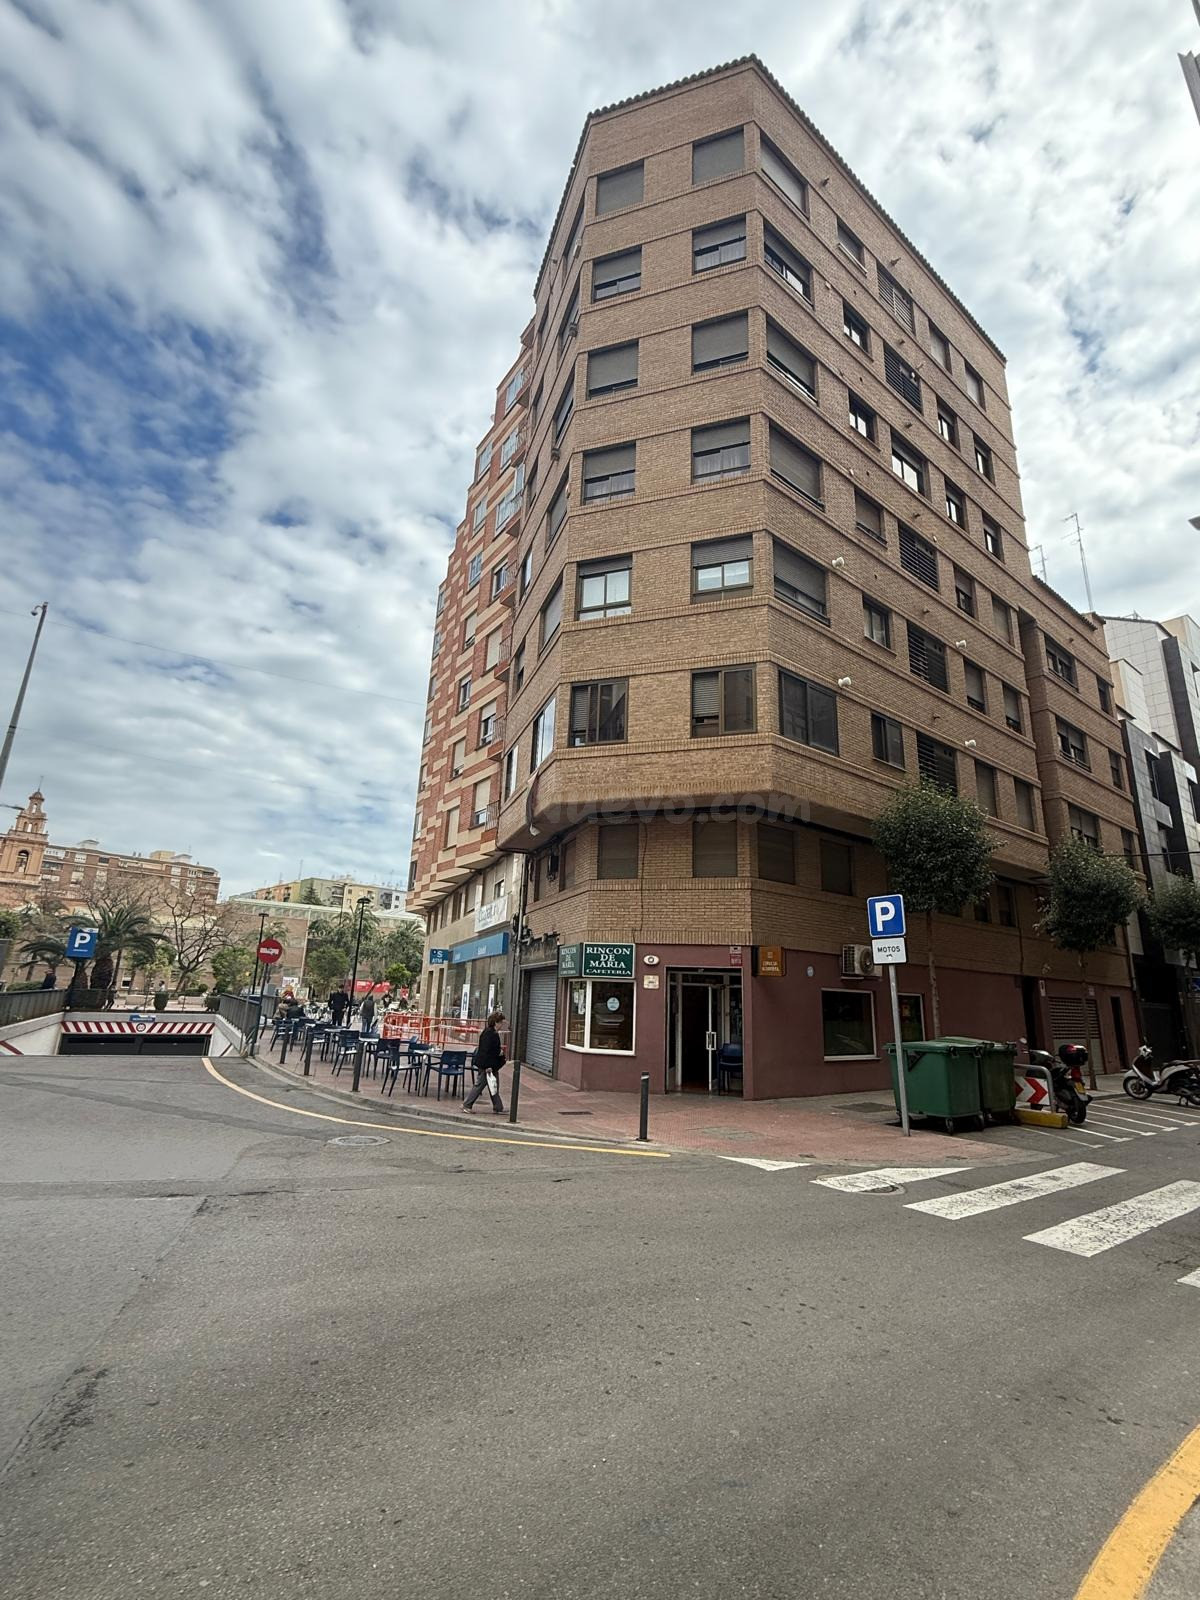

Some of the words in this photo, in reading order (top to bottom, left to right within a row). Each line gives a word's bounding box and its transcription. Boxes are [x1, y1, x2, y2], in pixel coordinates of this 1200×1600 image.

[875, 901, 896, 932] P
[74, 932, 91, 948] P
[586, 947, 631, 955] RINCON
[877, 945, 901, 953] MOTOS
[600, 954, 616, 962] DE
[589, 960, 626, 969] MARIA
